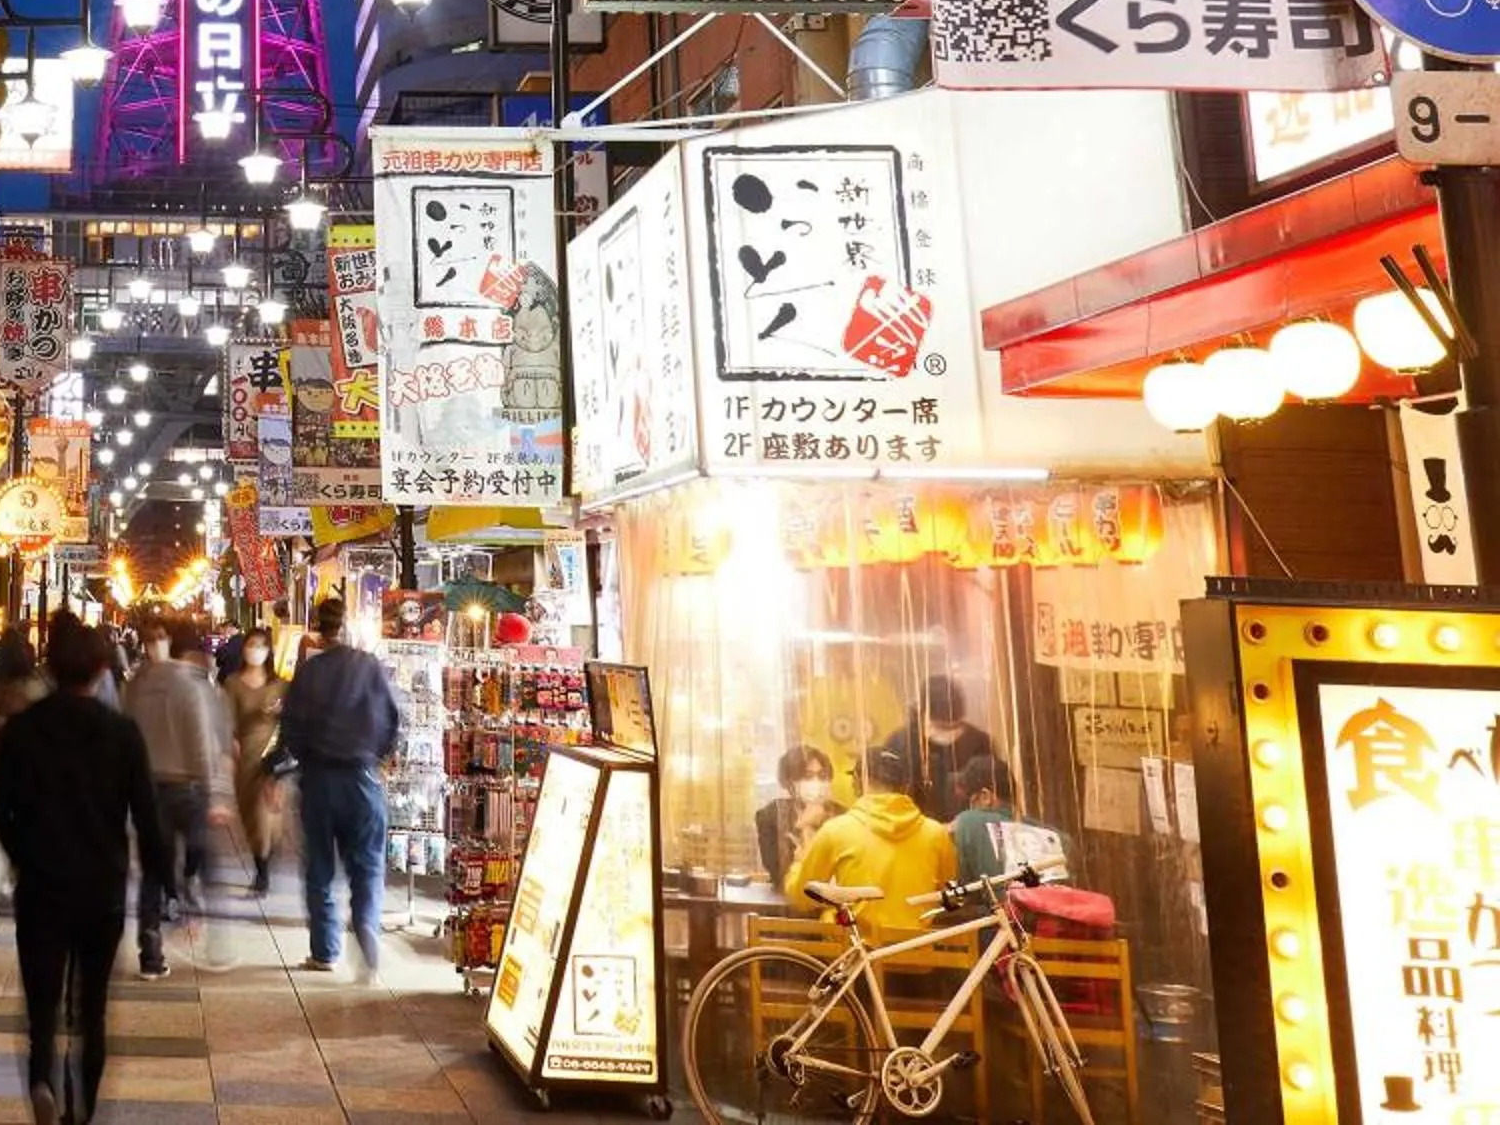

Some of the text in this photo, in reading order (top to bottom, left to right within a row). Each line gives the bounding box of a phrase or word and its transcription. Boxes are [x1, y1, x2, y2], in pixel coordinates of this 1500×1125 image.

[382, 149, 543, 173] 元祖串カツ専門店
[339, 272, 376, 290] おみ
[29, 267, 66, 359] 串かつ
[723, 396, 940, 424] 1F カウンター席
[723, 434, 943, 462] 2F 座敷あります
[319, 483, 382, 500] くら寿司
[390, 466, 556, 496] 宴会予約受付中
